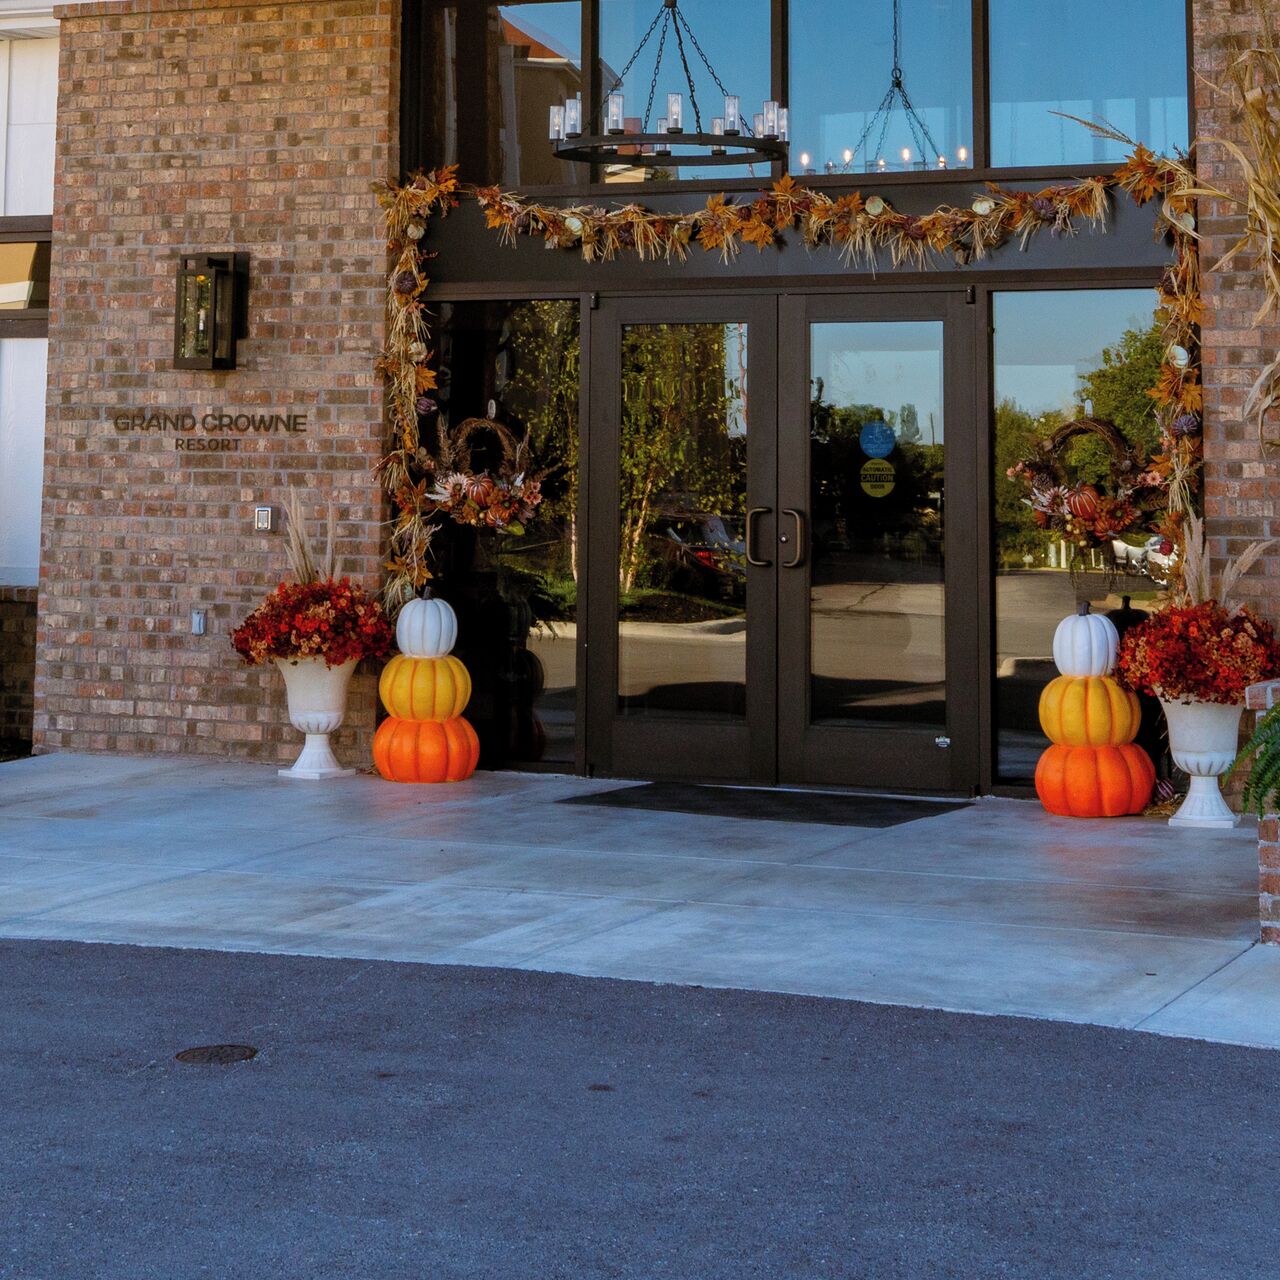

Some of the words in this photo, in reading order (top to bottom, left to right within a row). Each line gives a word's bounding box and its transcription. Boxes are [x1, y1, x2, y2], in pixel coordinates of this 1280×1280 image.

[113, 413, 196, 433] GRAND
[201, 413, 308, 433] CROWNE
[175, 437, 241, 452] RESORT
[861, 474, 894, 482] CAUTION
